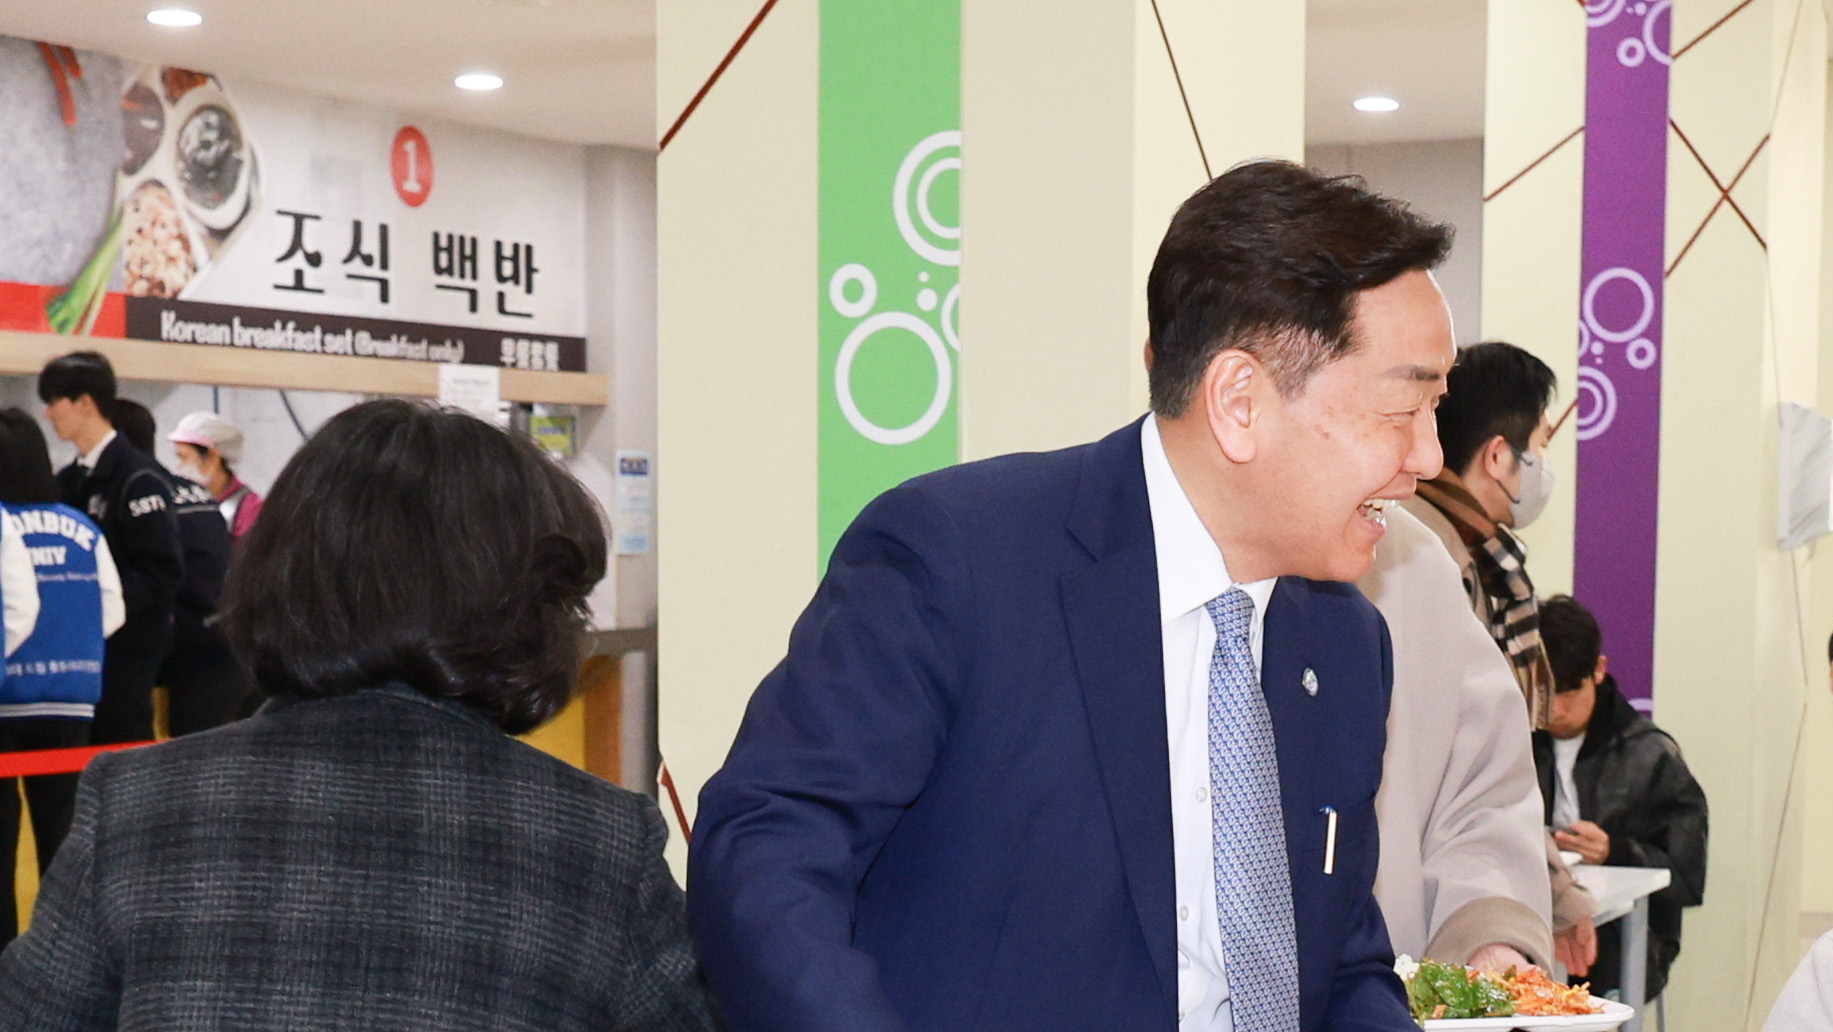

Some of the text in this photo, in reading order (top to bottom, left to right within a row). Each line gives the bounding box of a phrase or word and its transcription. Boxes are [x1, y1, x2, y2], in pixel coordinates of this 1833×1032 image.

[402, 139, 422, 194] 1
[272, 209, 540, 319] 조식 백반
[160, 309, 231, 346] Korean
[232, 315, 323, 353] breakfast
[323, 328, 354, 355] set
[11, 510, 96, 552] ONBUK
[29, 545, 68, 566] NIV
